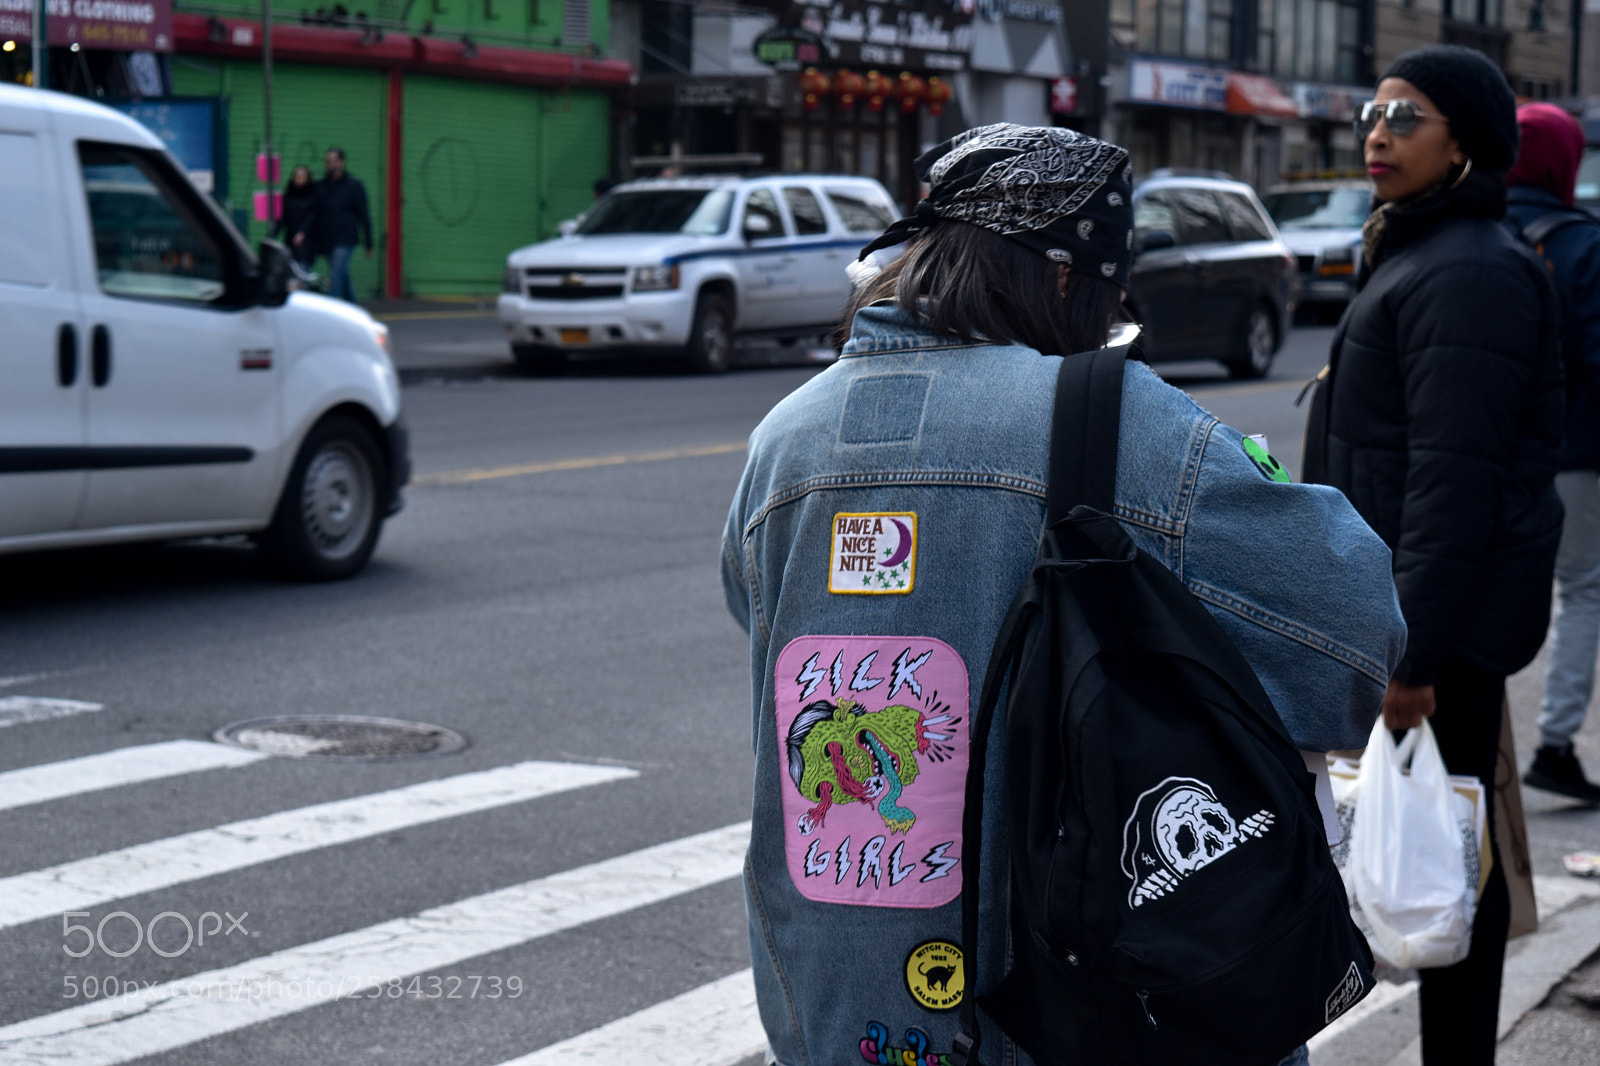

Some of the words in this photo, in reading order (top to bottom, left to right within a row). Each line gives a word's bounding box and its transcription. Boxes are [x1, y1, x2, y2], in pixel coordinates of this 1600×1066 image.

[837, 518, 872, 535] HAVE
[872, 518, 884, 535] A
[841, 536, 877, 553] NICE
[839, 555, 876, 572] NITE
[803, 834, 960, 889] GIRLS
[916, 944, 941, 959] WITCH
[944, 946, 962, 960] CITY
[914, 985, 939, 1005] SALEM
